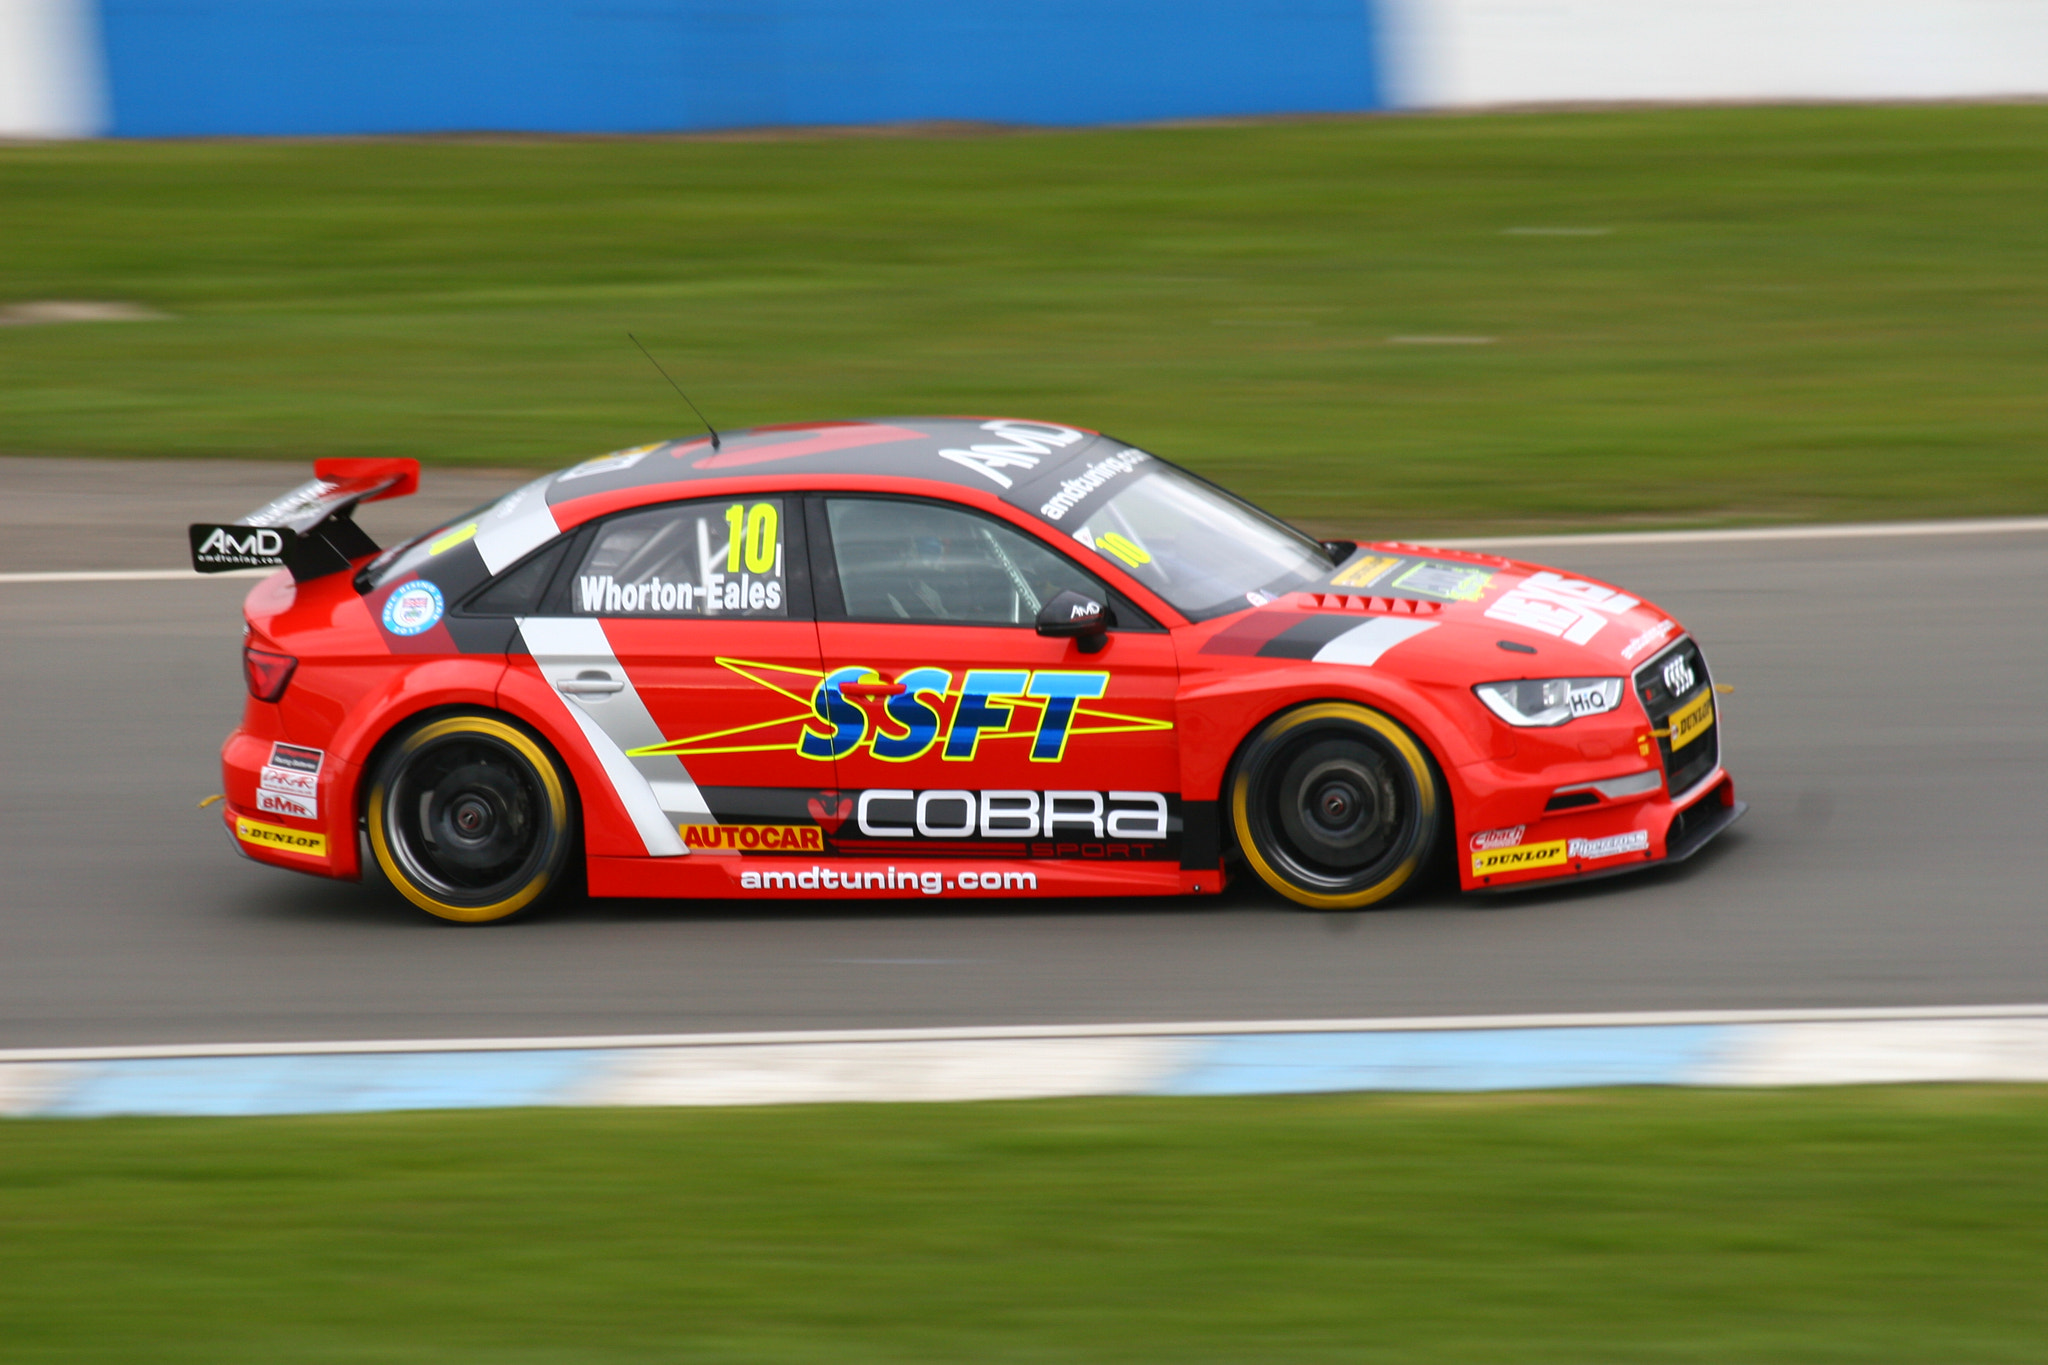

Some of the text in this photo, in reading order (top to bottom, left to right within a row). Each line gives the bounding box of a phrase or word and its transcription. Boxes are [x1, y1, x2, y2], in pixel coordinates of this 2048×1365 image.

[725, 502, 778, 574] 10
[1095, 531, 1151, 568] 10
[580, 573, 782, 611] Whorton-Eales
[797, 667, 1109, 762] SSFT
[1571, 691, 1604, 713] HiQ
[1680, 702, 1712, 736] DUNLOP
[263, 796, 306, 815] BMR
[251, 828, 320, 847] DUNLOP
[683, 826, 820, 850] AUTOCAR
[1031, 842, 1154, 858] SPORT
[1486, 848, 1560, 867] DUNLOP
[740, 866, 1037, 895] amdtuning.com
